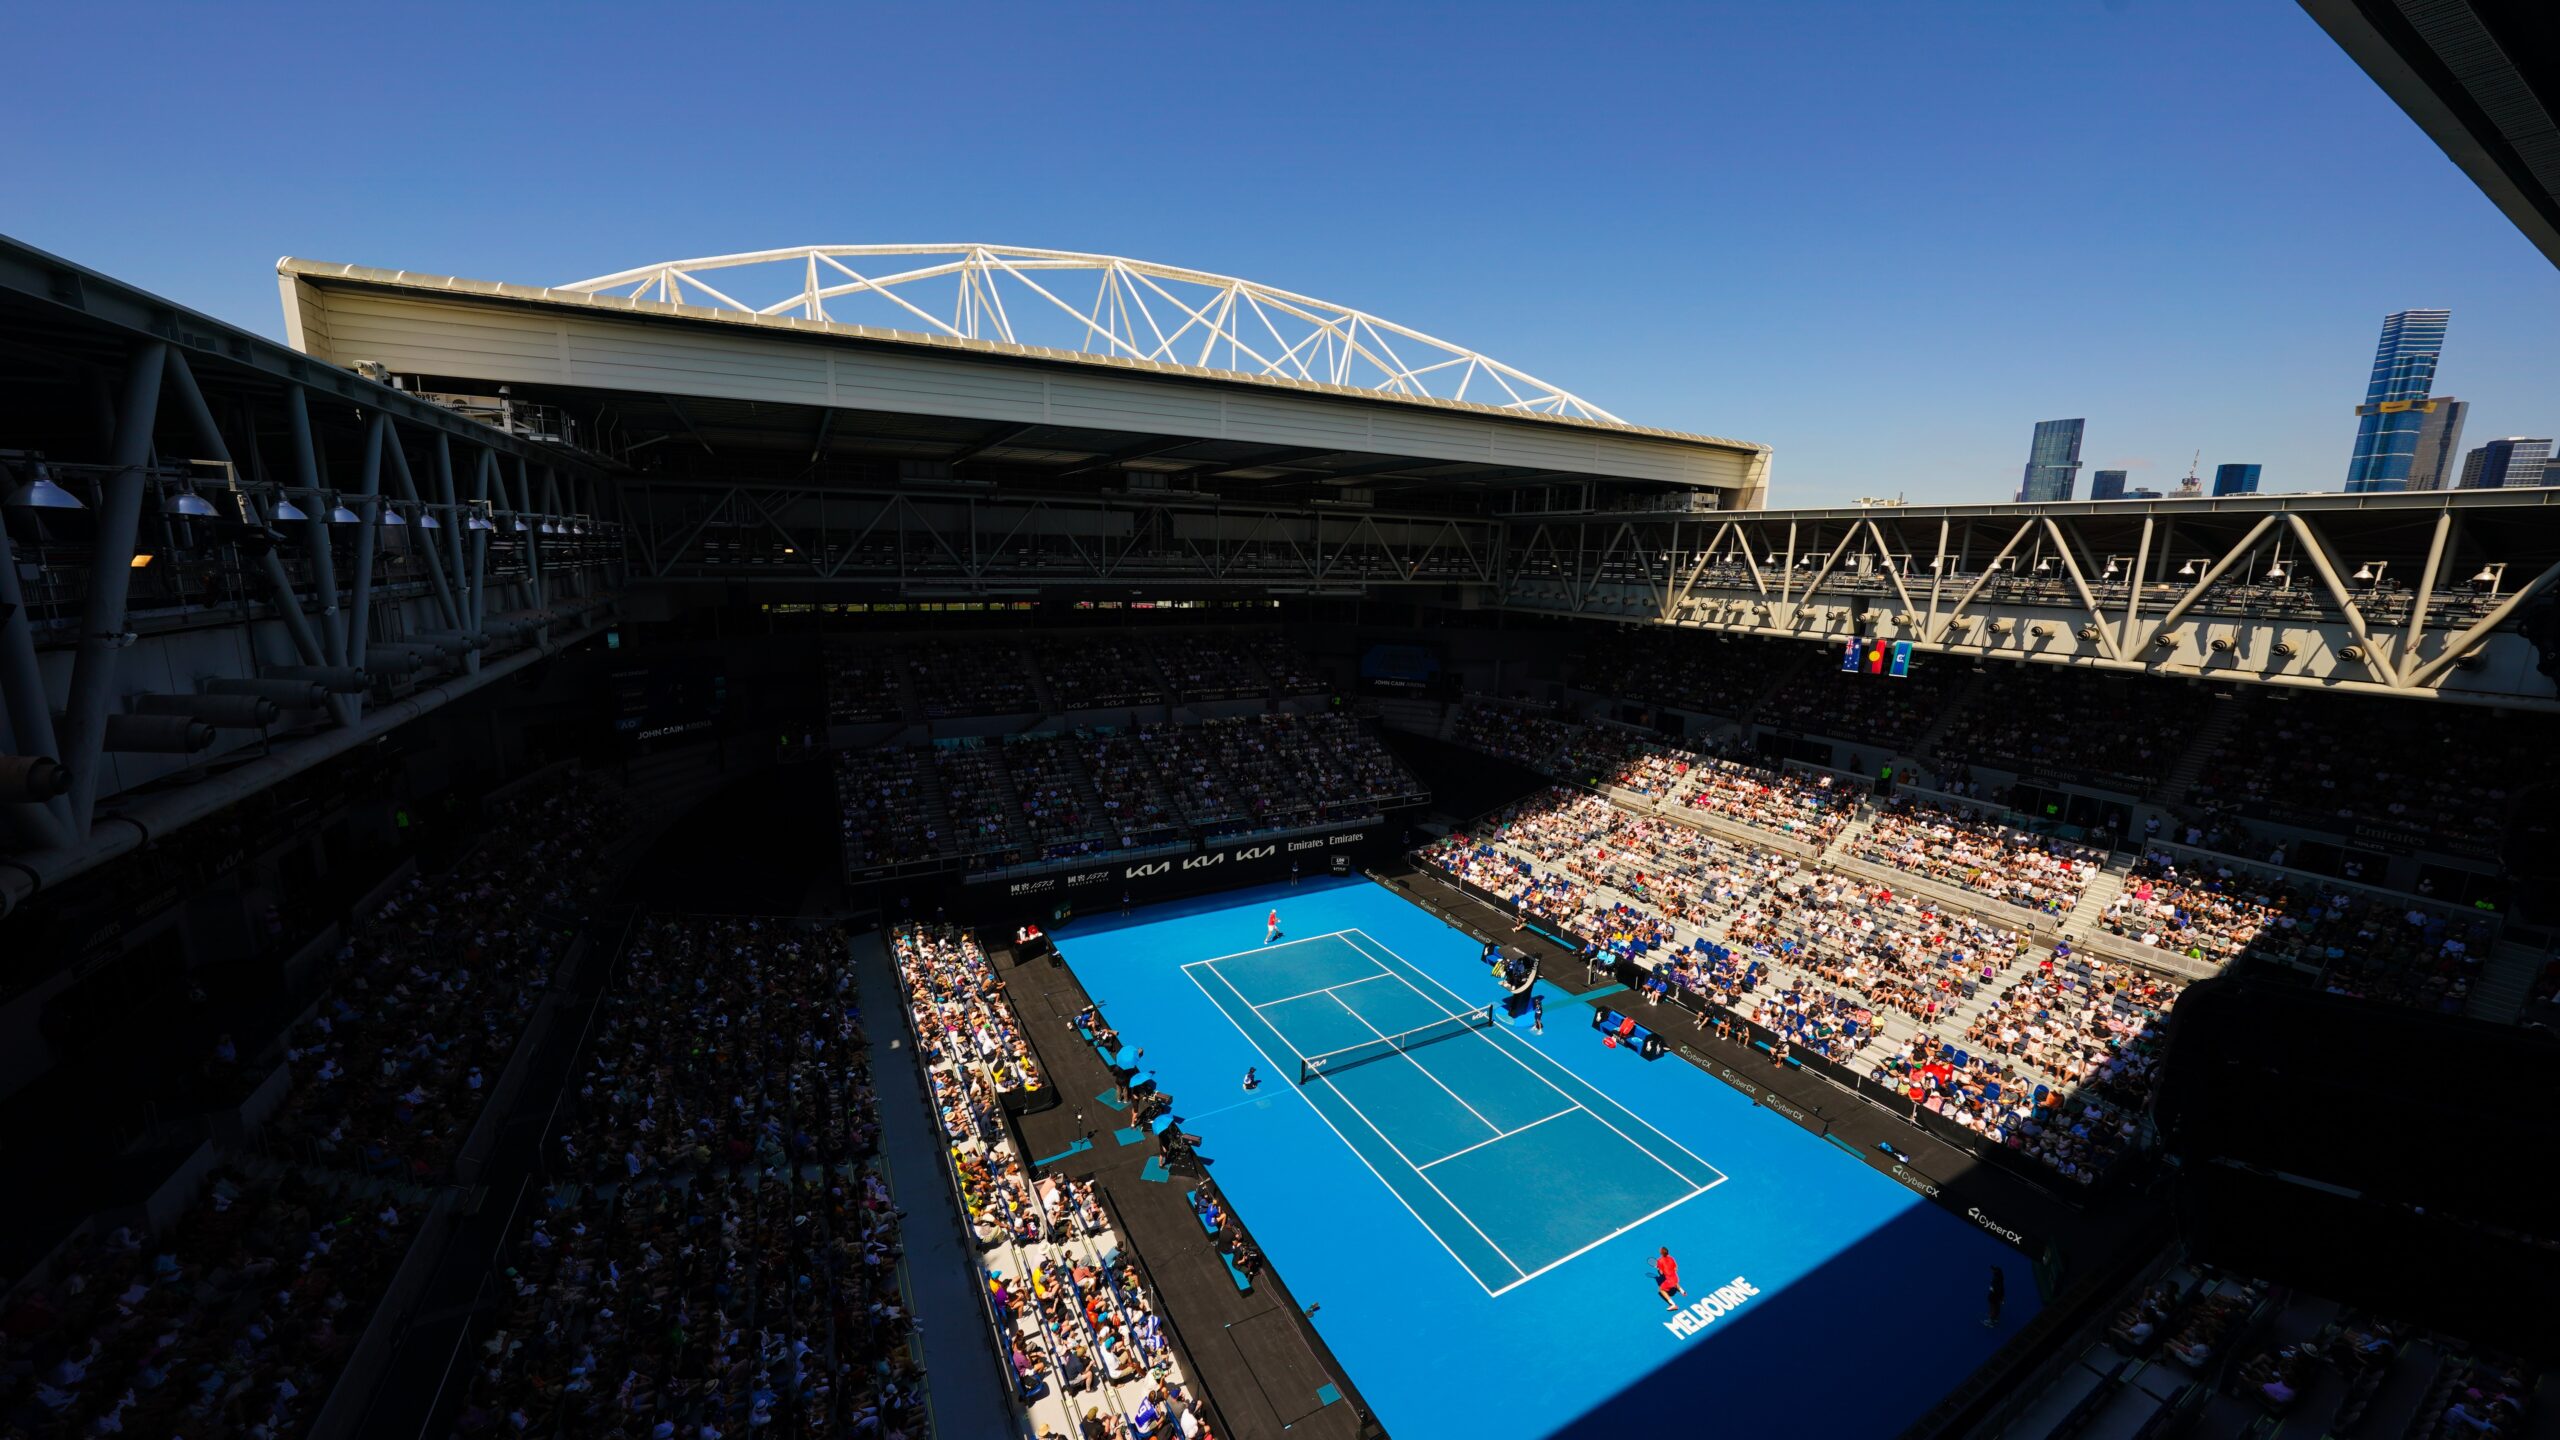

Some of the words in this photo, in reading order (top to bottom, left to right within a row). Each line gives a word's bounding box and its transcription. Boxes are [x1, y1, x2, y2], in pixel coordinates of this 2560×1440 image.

[1374, 679, 1390, 687] JOHN
[637, 728, 662, 740] JOHN
[662, 724, 684, 735] CAIN
[2033, 766, 2078, 782] Emirates
[1329, 832, 1364, 846] Emirates
[2355, 824, 2426, 847] Emirates
[1236, 845, 1275, 861] KIA
[1287, 839, 1324, 852] Emirates
[1125, 861, 1170, 878] KIA
[1182, 852, 1224, 870] KIA
[1686, 1050, 1712, 1069] CyberCX
[1728, 1074, 1757, 1095] CyberCX
[1773, 1099, 1805, 1121] CyberCX
[1901, 1170, 1940, 1198] CyberCX
[1978, 1214, 2023, 1245] CyberCX
[1662, 1276, 1760, 1340] MELBOURNE
